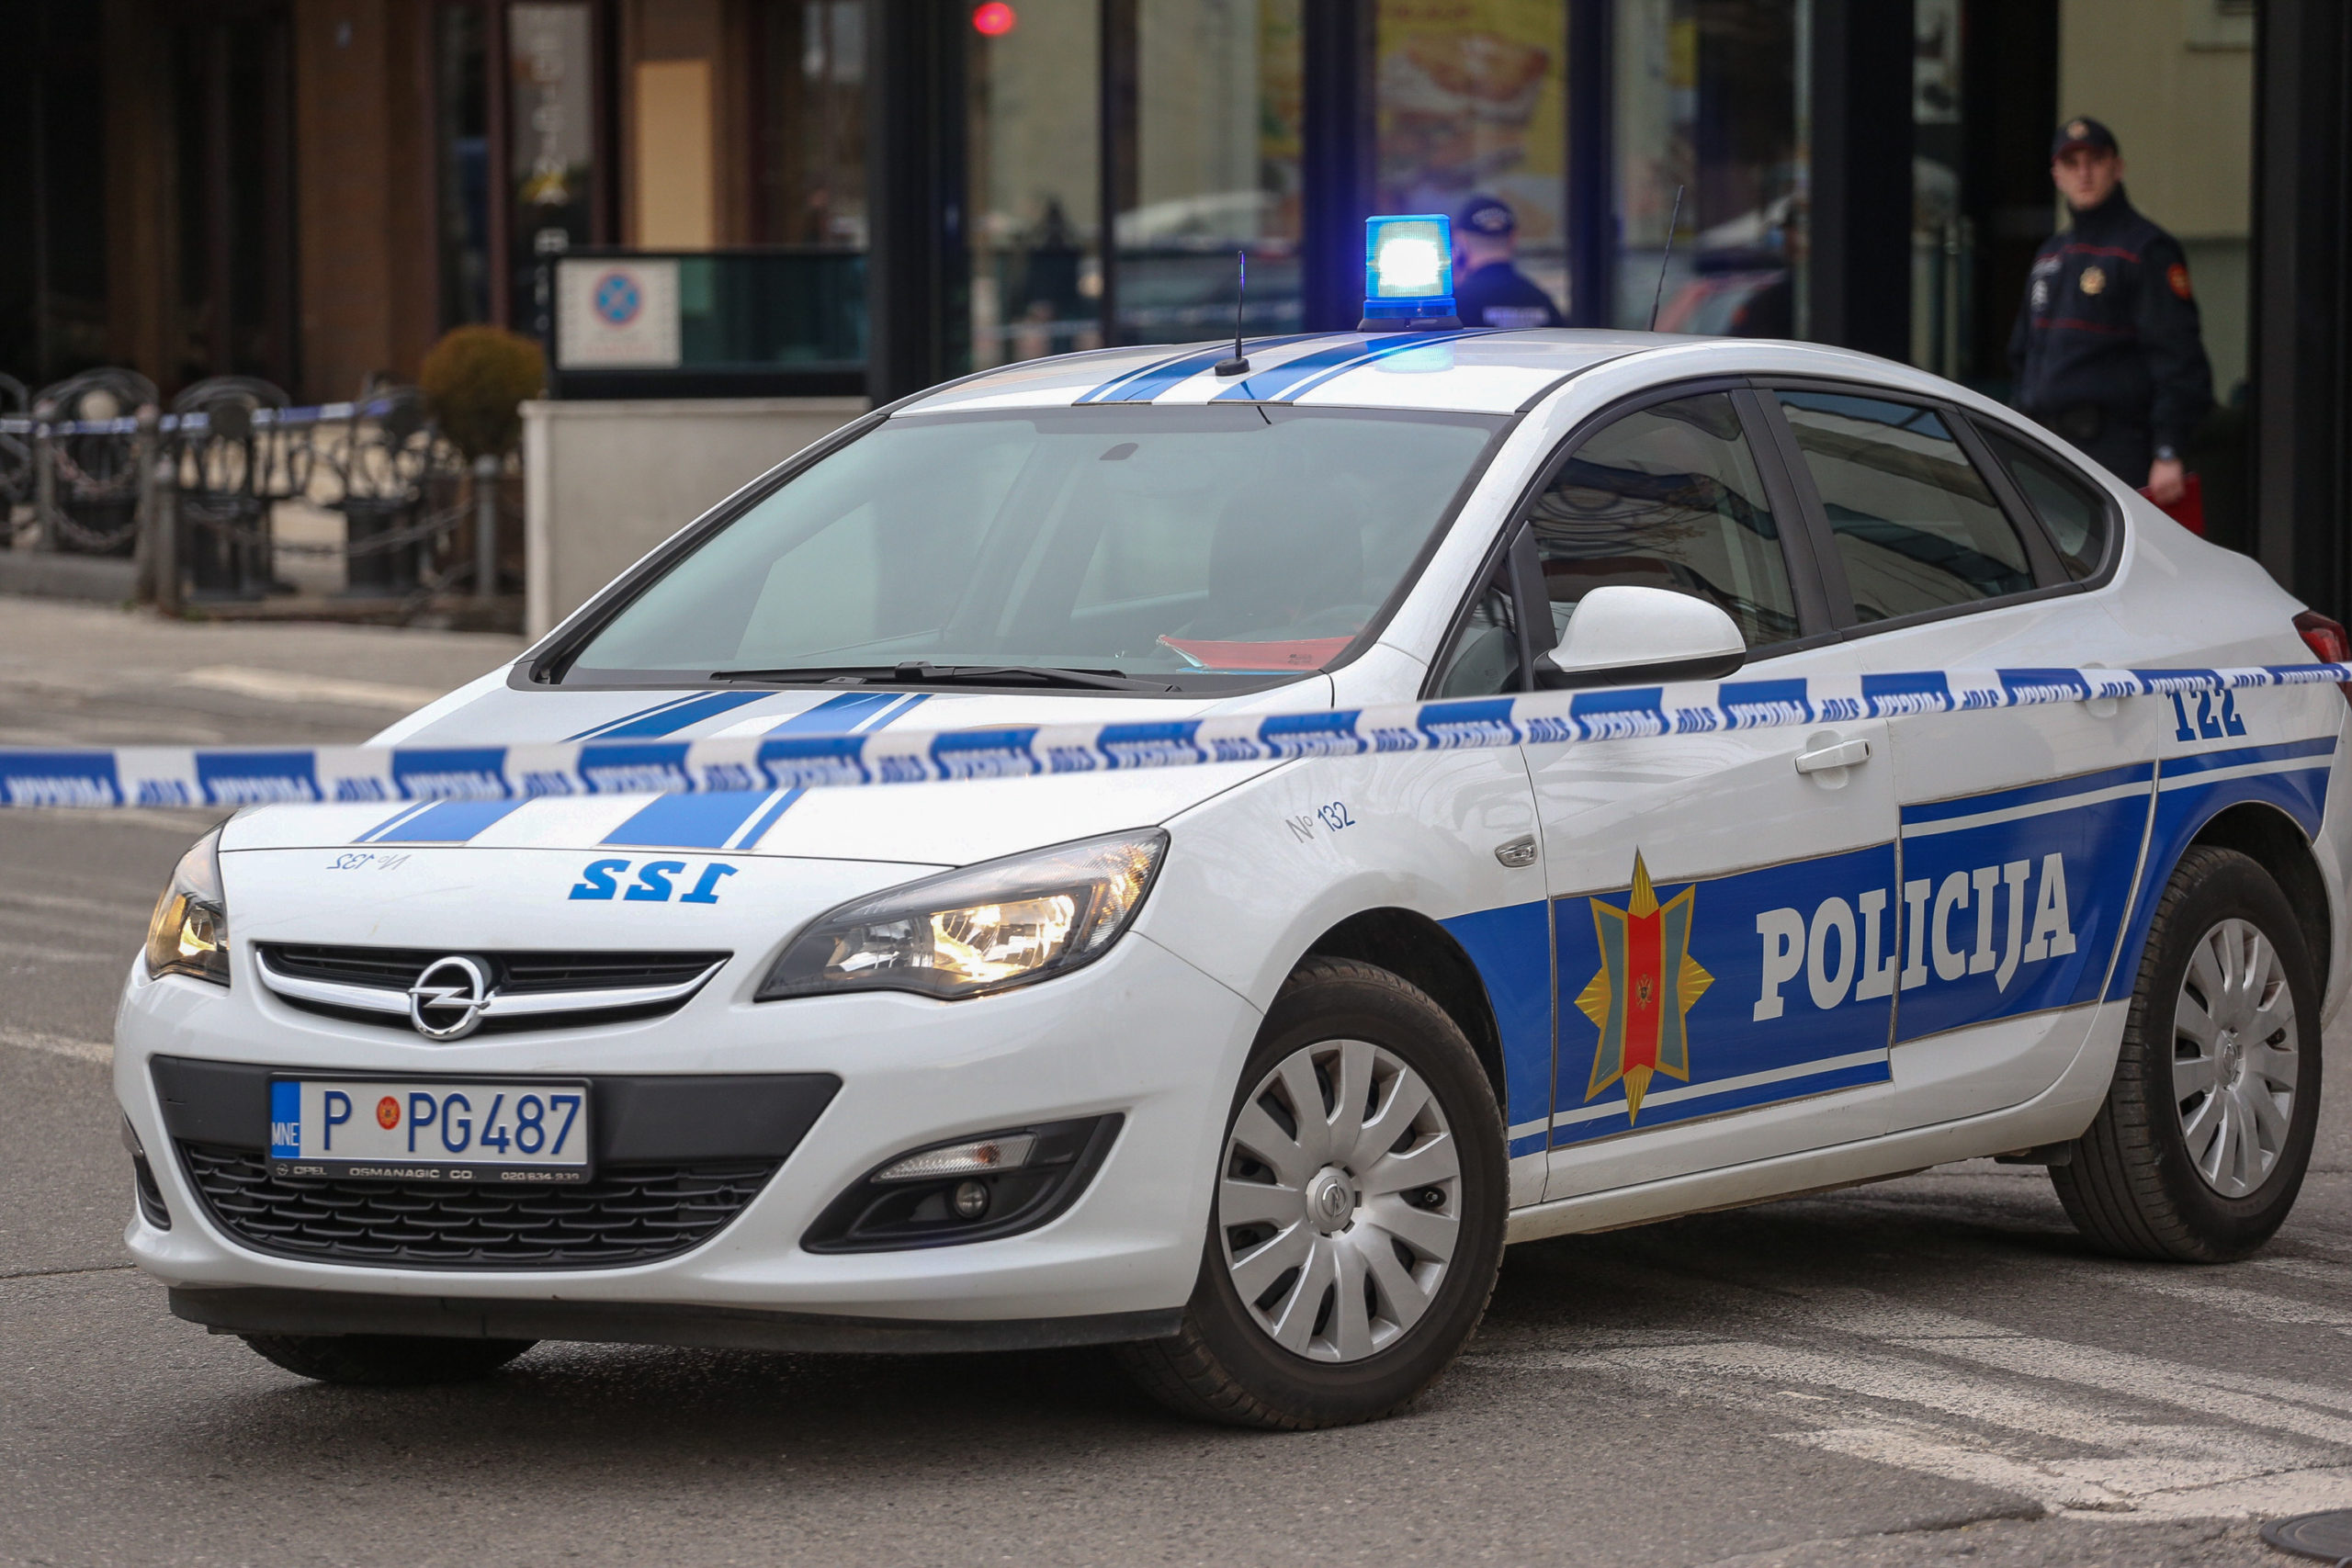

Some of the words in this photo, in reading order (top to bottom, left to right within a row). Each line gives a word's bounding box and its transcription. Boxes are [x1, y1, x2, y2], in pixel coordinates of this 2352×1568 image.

[2165, 688, 2247, 741] 122
[1317, 801, 1355, 831] 132
[1753, 852, 2076, 1021] POLICIJA
[272, 1122, 300, 1146] MNE
[323, 1090, 353, 1151] P
[408, 1091, 582, 1155] PG487
[293, 1166, 327, 1176] OPEL
[349, 1167, 440, 1179] OSMANAGIC
